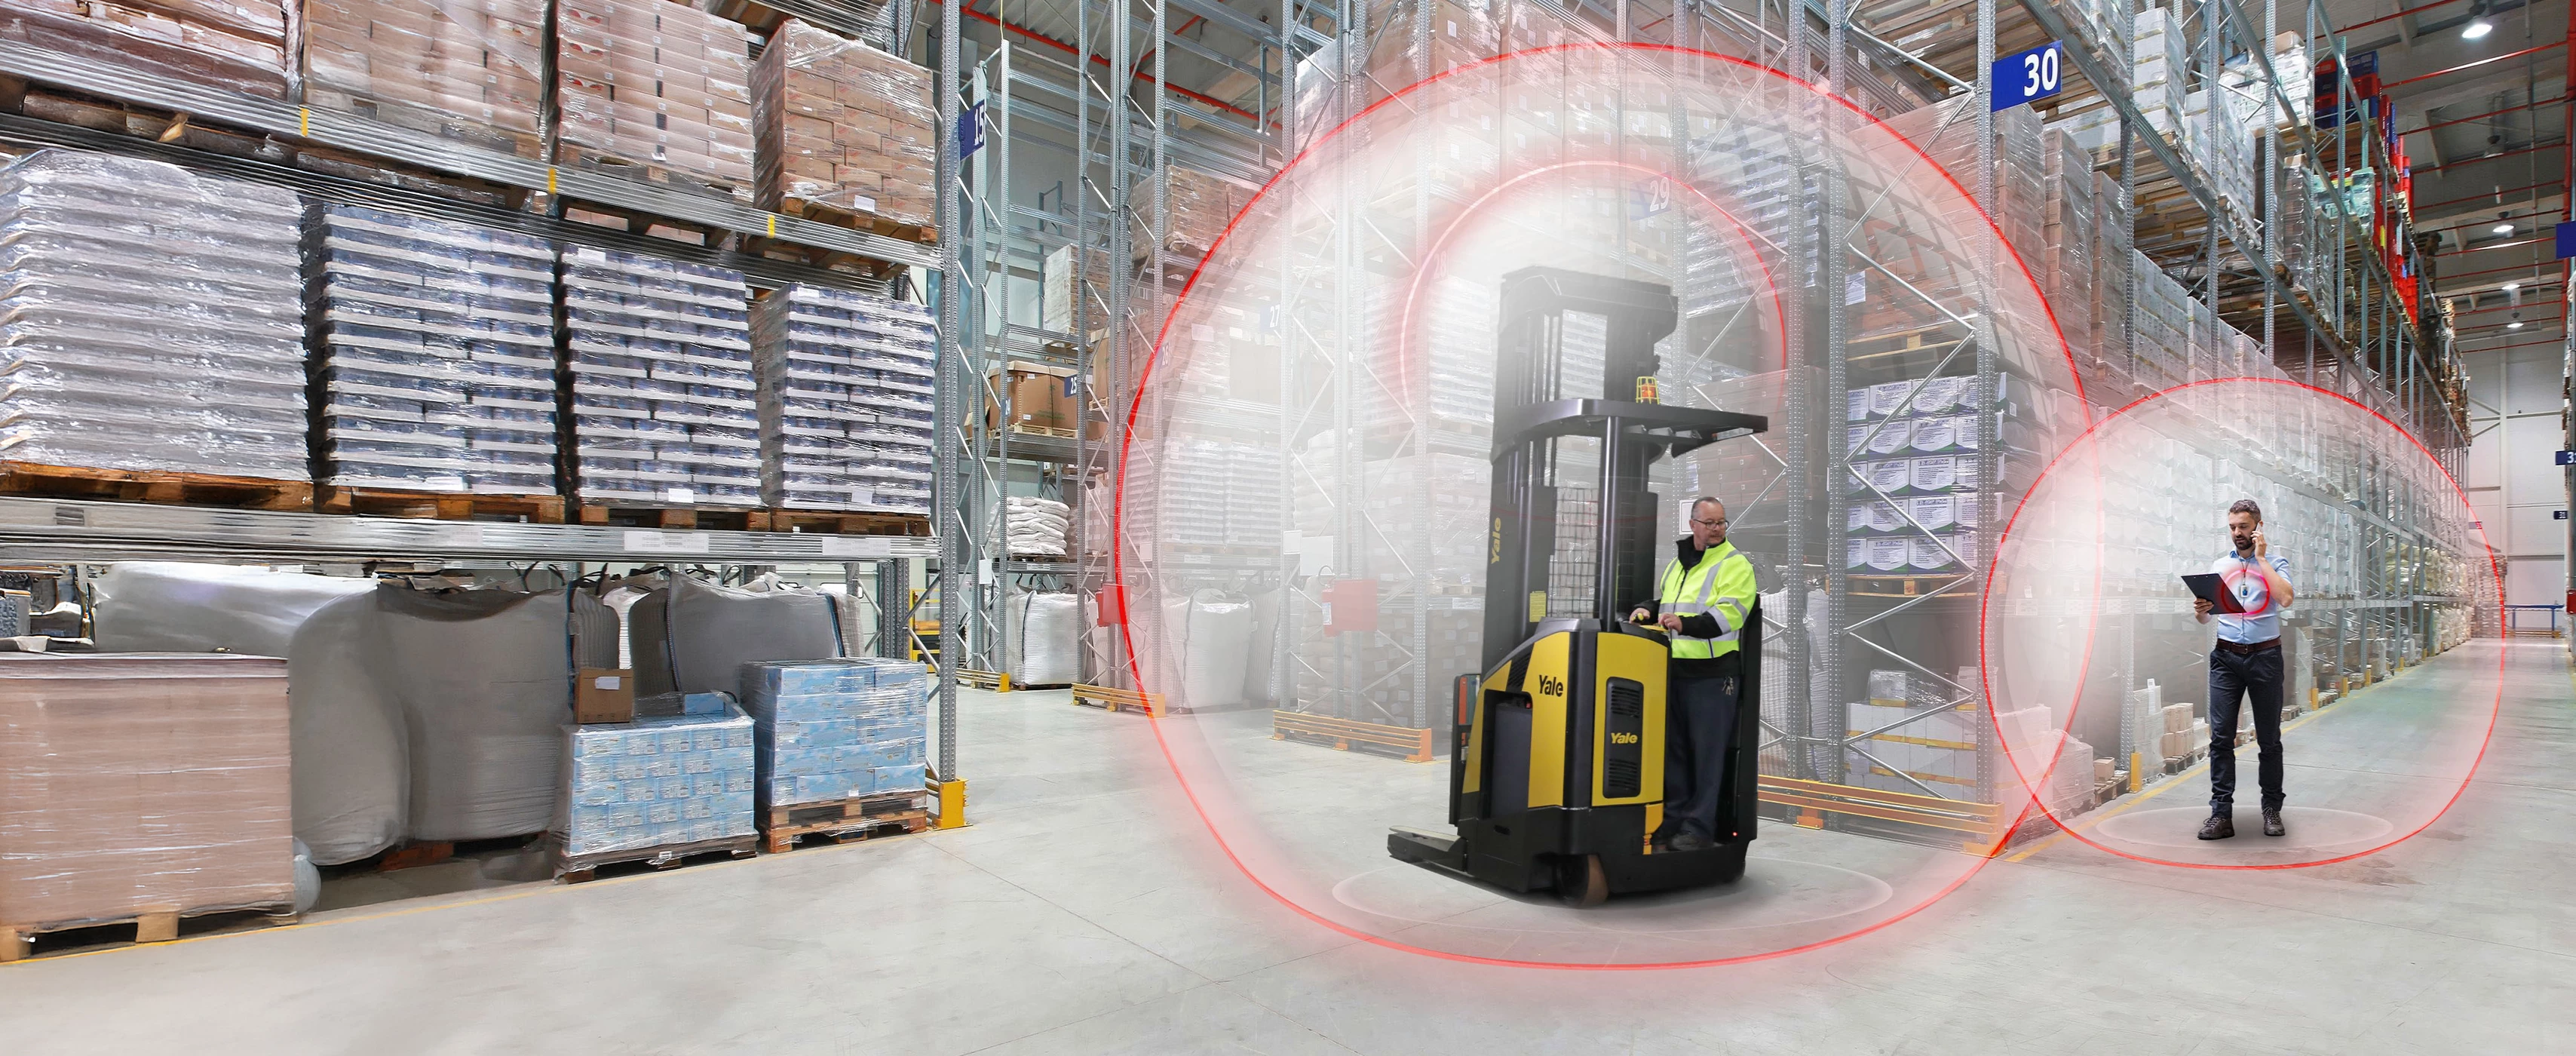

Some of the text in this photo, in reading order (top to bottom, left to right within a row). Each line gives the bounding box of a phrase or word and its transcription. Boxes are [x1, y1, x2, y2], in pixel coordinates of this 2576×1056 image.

[2024, 48, 2058, 97] 30
[974, 105, 984, 146] 15
[1649, 177, 1670, 212] 29
[1269, 304, 1280, 327] 27
[1070, 376, 1077, 394] 25
[2567, 451, 2576, 464] 3
[1491, 517, 1501, 564] Yale
[1538, 674, 1563, 697] Yale
[1610, 732, 1638, 744] Yale
